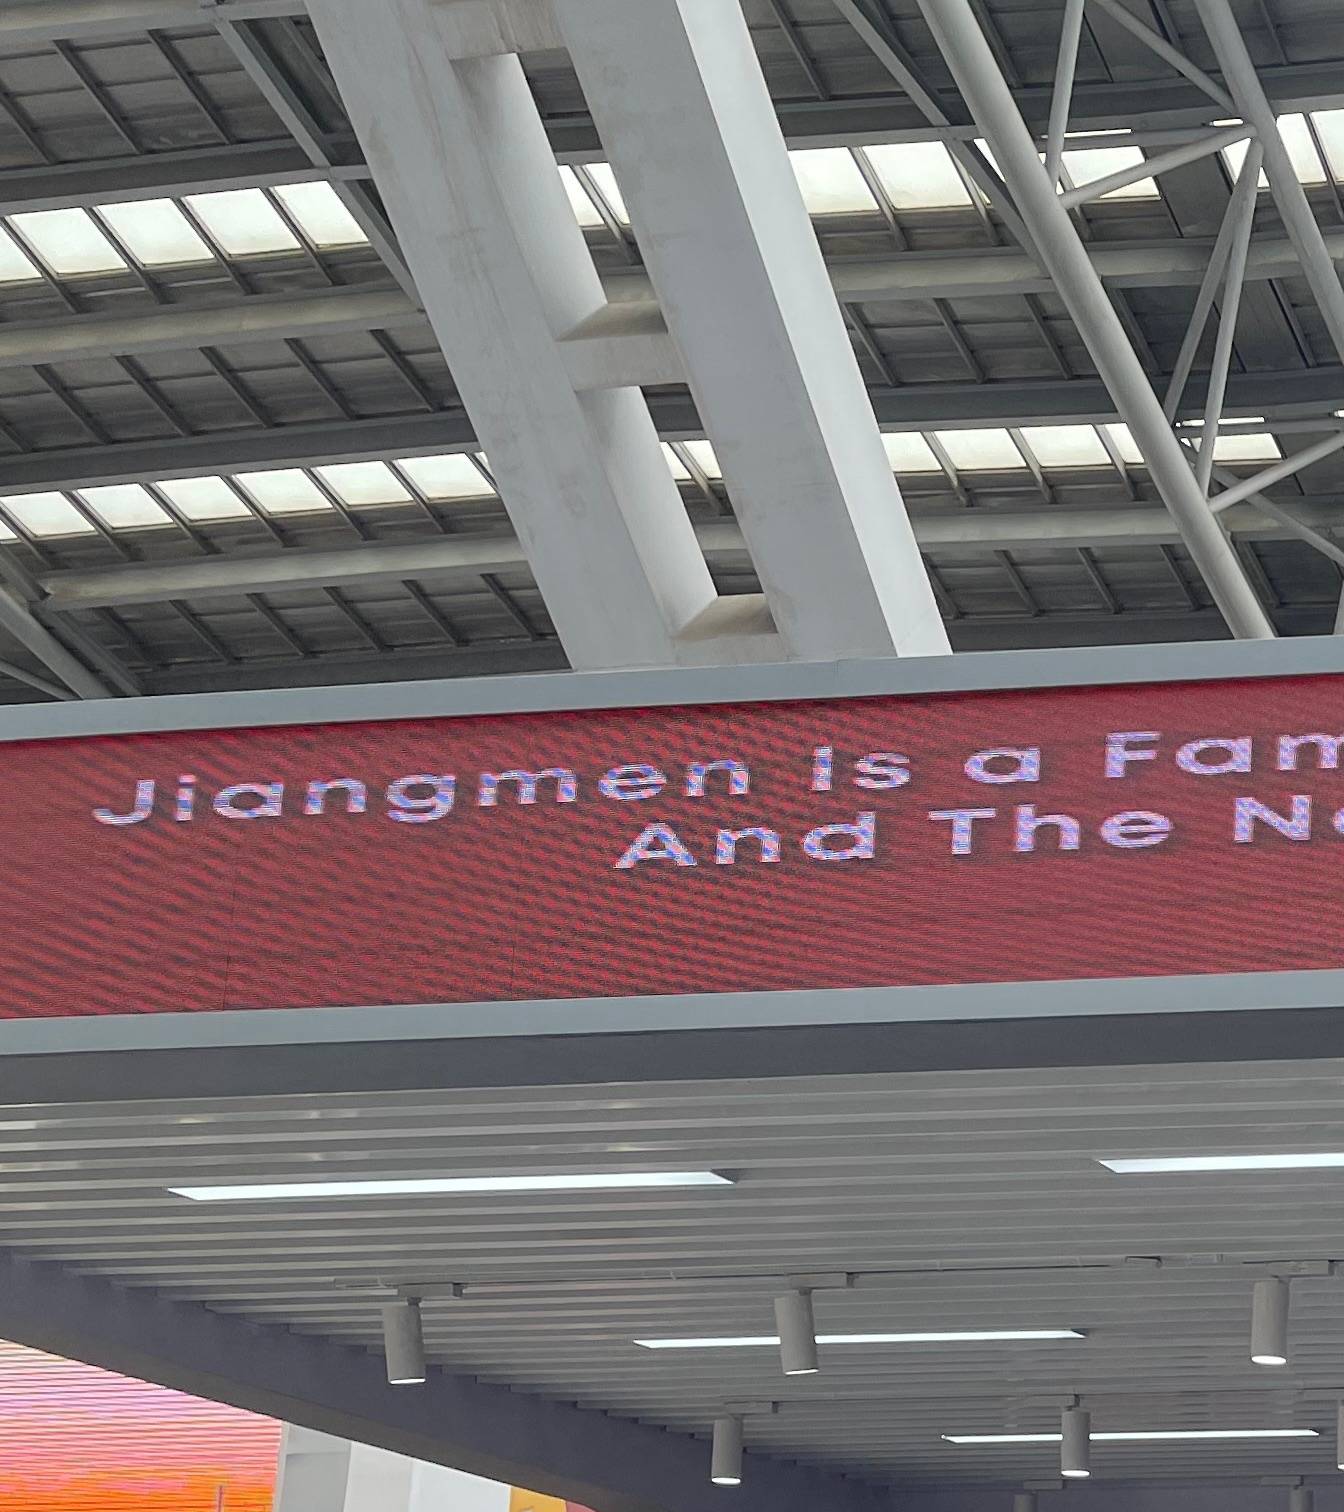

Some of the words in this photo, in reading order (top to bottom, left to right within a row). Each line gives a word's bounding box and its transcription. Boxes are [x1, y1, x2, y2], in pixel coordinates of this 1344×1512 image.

[93, 757, 749, 826] Jiangmen
[811, 745, 912, 791] Is
[964, 746, 1041, 784] a
[611, 811, 876, 869] And
[928, 803, 1174, 855] The
